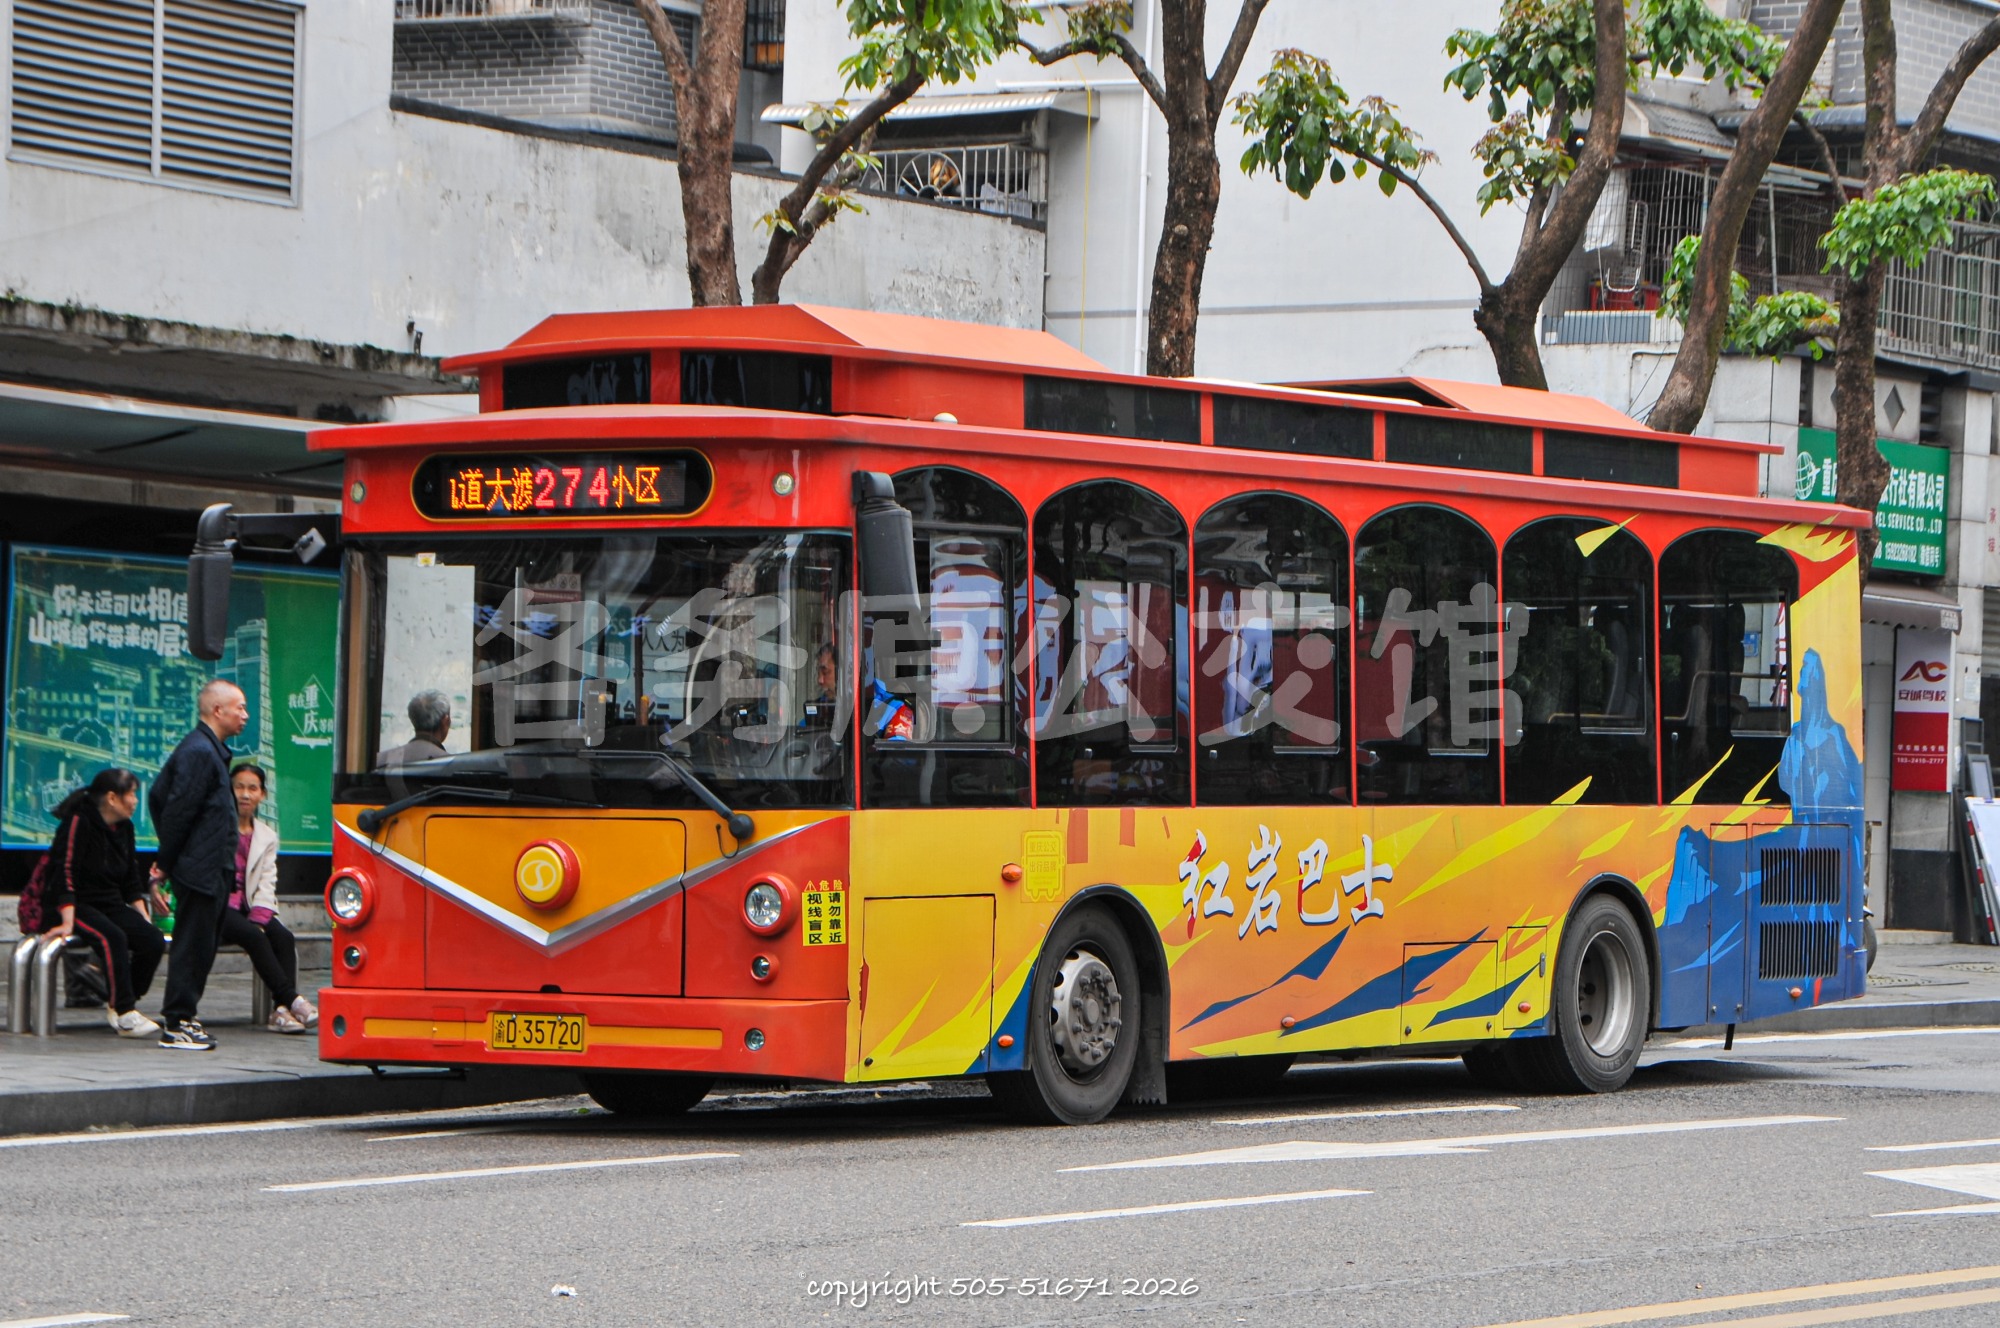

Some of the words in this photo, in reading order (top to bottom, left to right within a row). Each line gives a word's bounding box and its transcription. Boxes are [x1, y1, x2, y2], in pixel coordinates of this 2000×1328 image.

[450, 466, 533, 511] 道大渡
[534, 467, 609, 507] 274
[612, 465, 660, 508] 小区
[1888, 513, 1915, 531] SERVICE
[53, 584, 188, 624] 你永远可以相信
[1898, 689, 1947, 702] 安诚驾校
[820, 880, 843, 891] 危险
[1029, 861, 1057, 873] 出行品牌
[1179, 824, 1393, 941] 红岩巴士
[807, 893, 823, 945] 视线盲区
[828, 892, 842, 943] 请勿靠近
